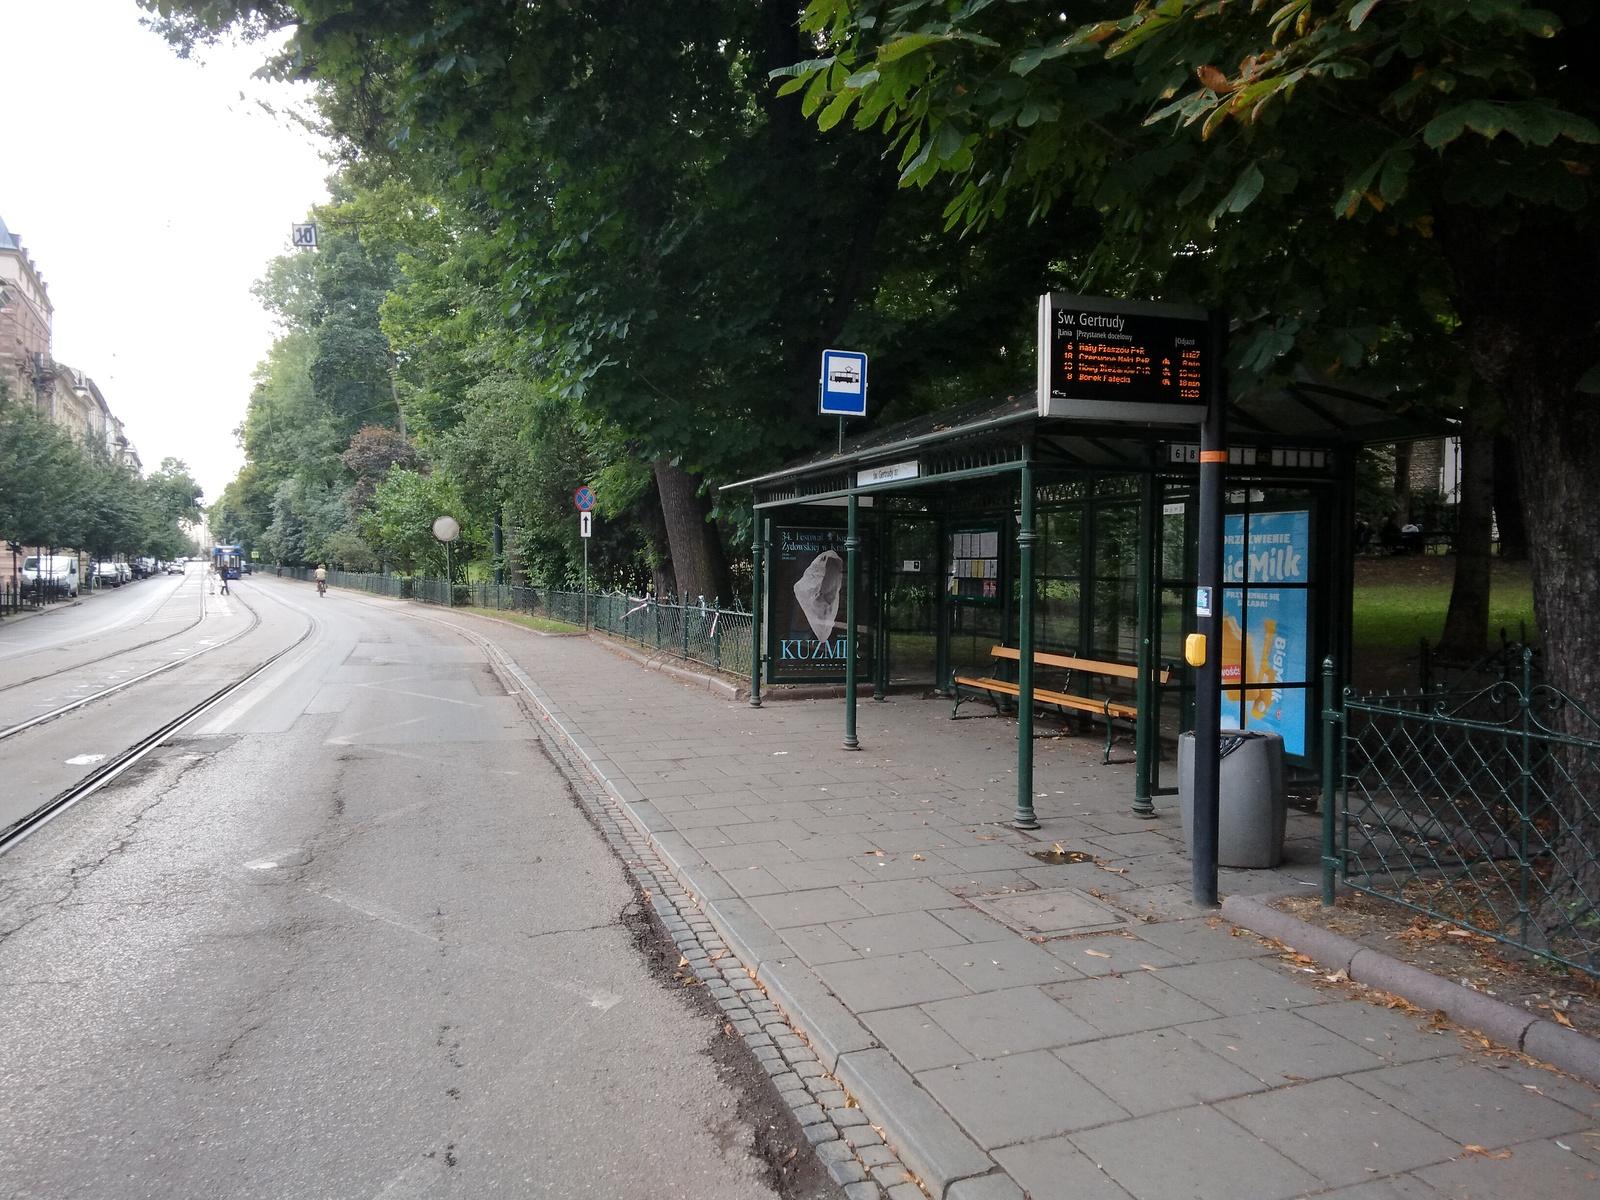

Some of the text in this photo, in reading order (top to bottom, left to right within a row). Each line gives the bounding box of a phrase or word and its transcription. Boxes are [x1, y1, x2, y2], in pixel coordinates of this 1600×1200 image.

[295, 227, 312, 243] 10
[1058, 308, 1125, 332] Św. Gertrudy
[1078, 329, 1133, 342] Przystanek docelowy
[1079, 374, 1101, 382] Borek
[1176, 449, 1180, 458] 6
[1190, 450, 1195, 459] 8
